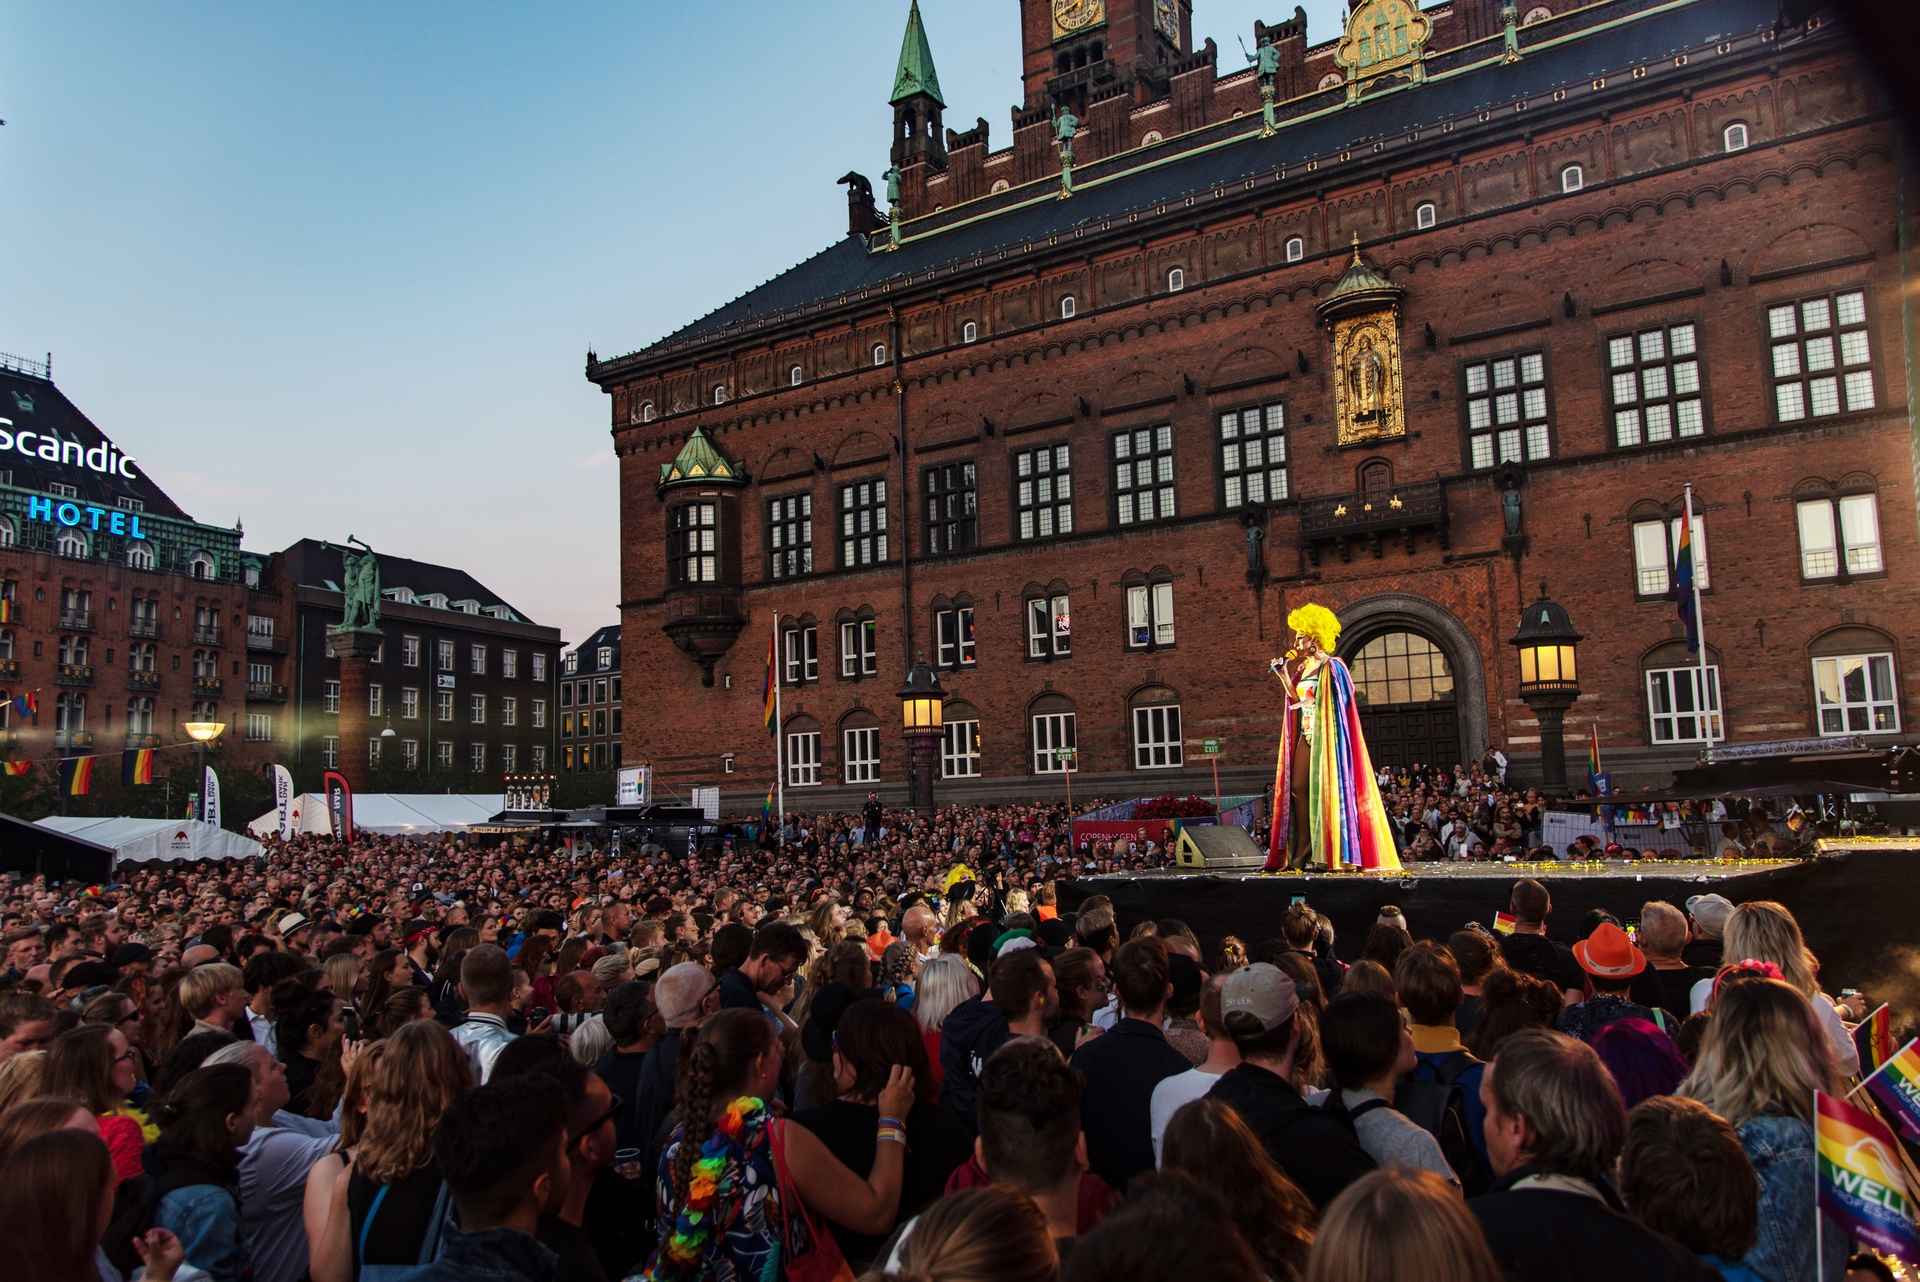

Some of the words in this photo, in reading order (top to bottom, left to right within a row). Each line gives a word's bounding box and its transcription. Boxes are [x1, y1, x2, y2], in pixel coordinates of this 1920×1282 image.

[0, 417, 137, 479] Scandic
[29, 495, 146, 540] HOTEL
[1080, 832, 1137, 842] COPENHGEN
